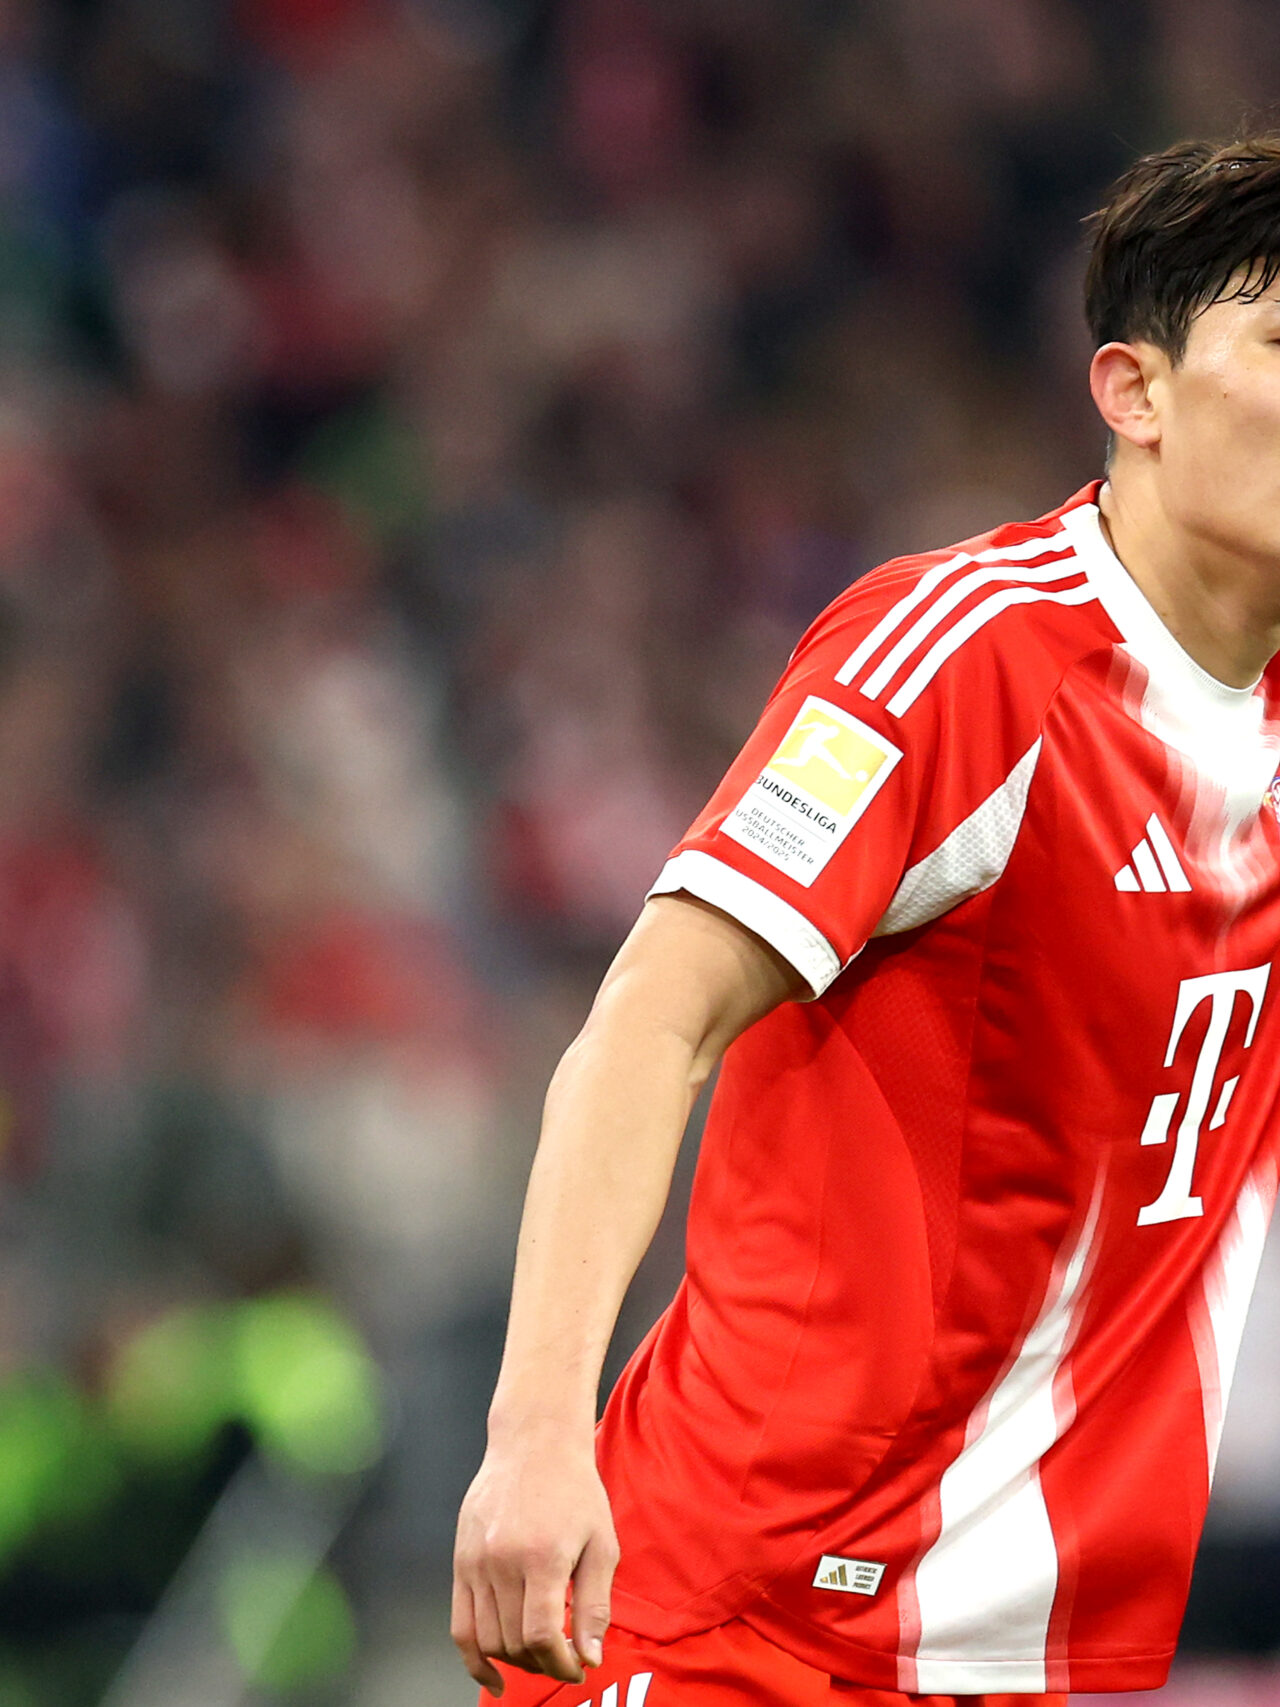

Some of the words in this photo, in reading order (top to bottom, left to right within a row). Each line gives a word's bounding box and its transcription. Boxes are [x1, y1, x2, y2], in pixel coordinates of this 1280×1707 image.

[735, 809, 815, 864] USSBALLMEISTER
[741, 825, 790, 861] 2024/2025
[751, 807, 806, 846] DEUTSCHER
